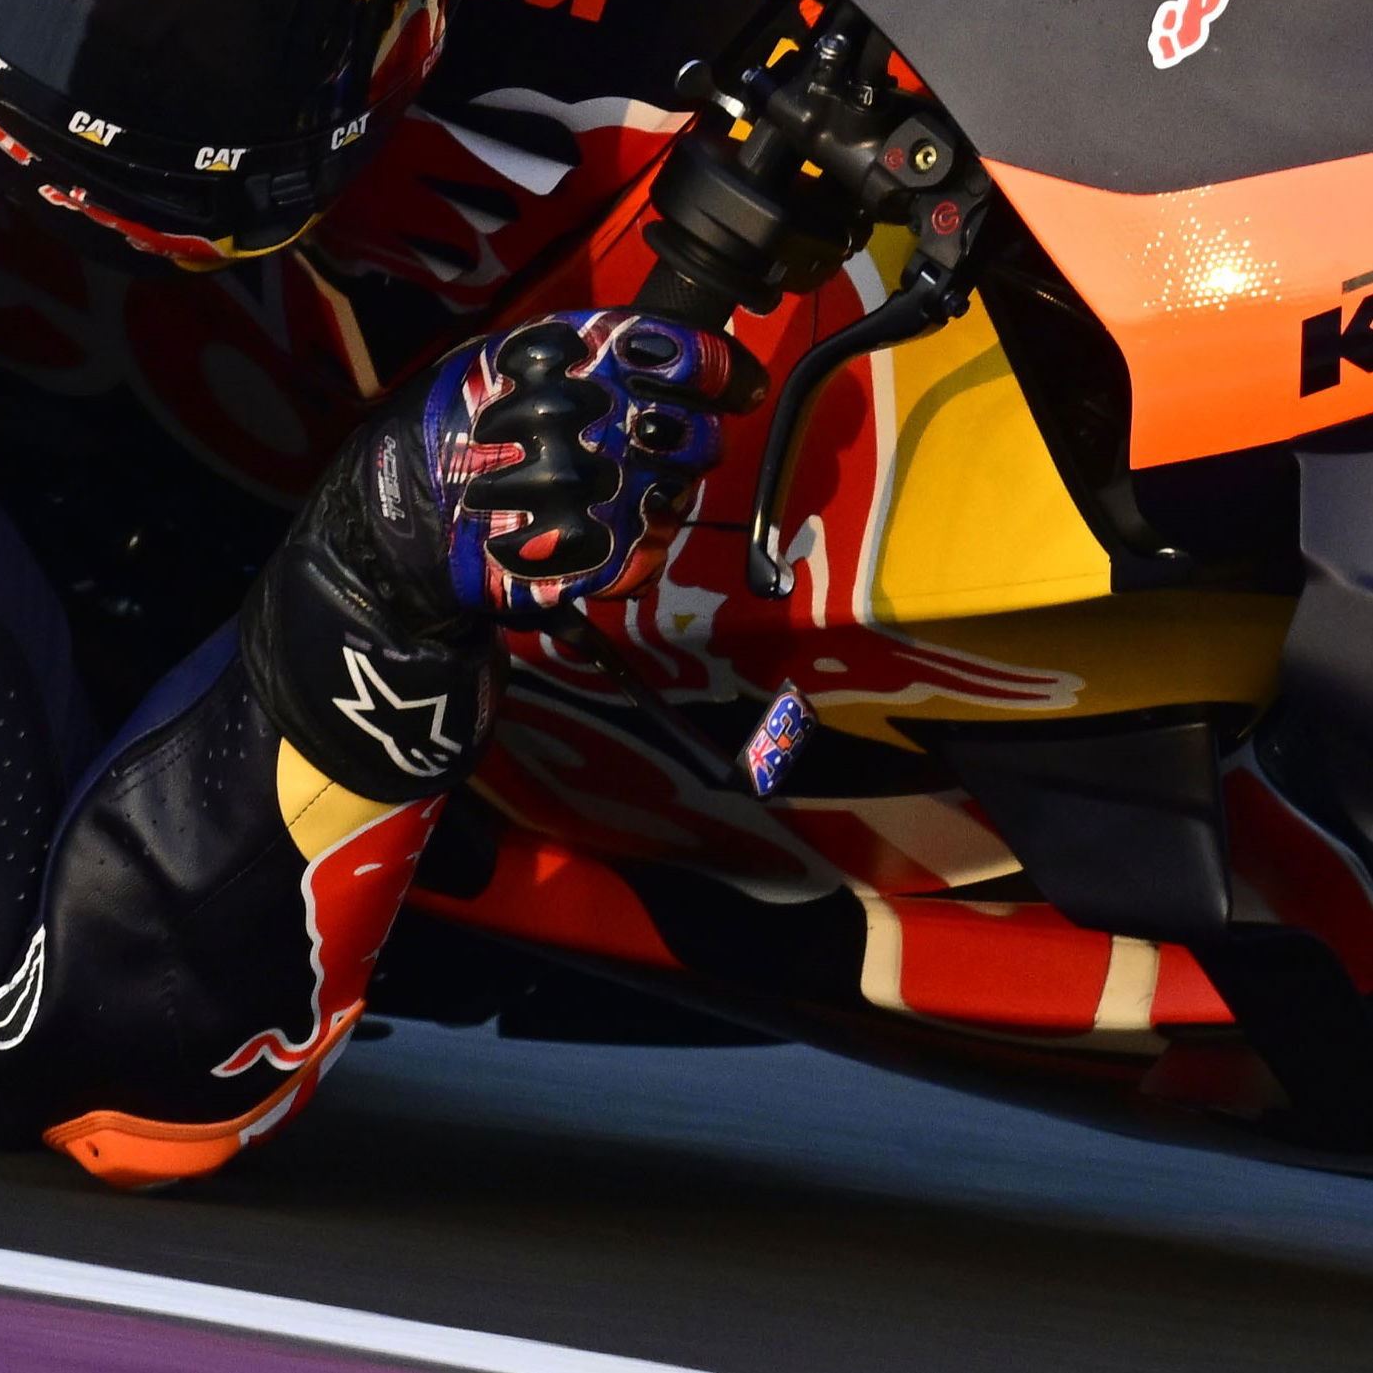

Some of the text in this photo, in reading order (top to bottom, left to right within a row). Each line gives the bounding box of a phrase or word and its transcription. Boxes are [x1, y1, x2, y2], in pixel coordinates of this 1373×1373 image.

[68, 111, 123, 148] CAT
[331, 112, 371, 151] CAT
[194, 146, 247, 172] CAT
